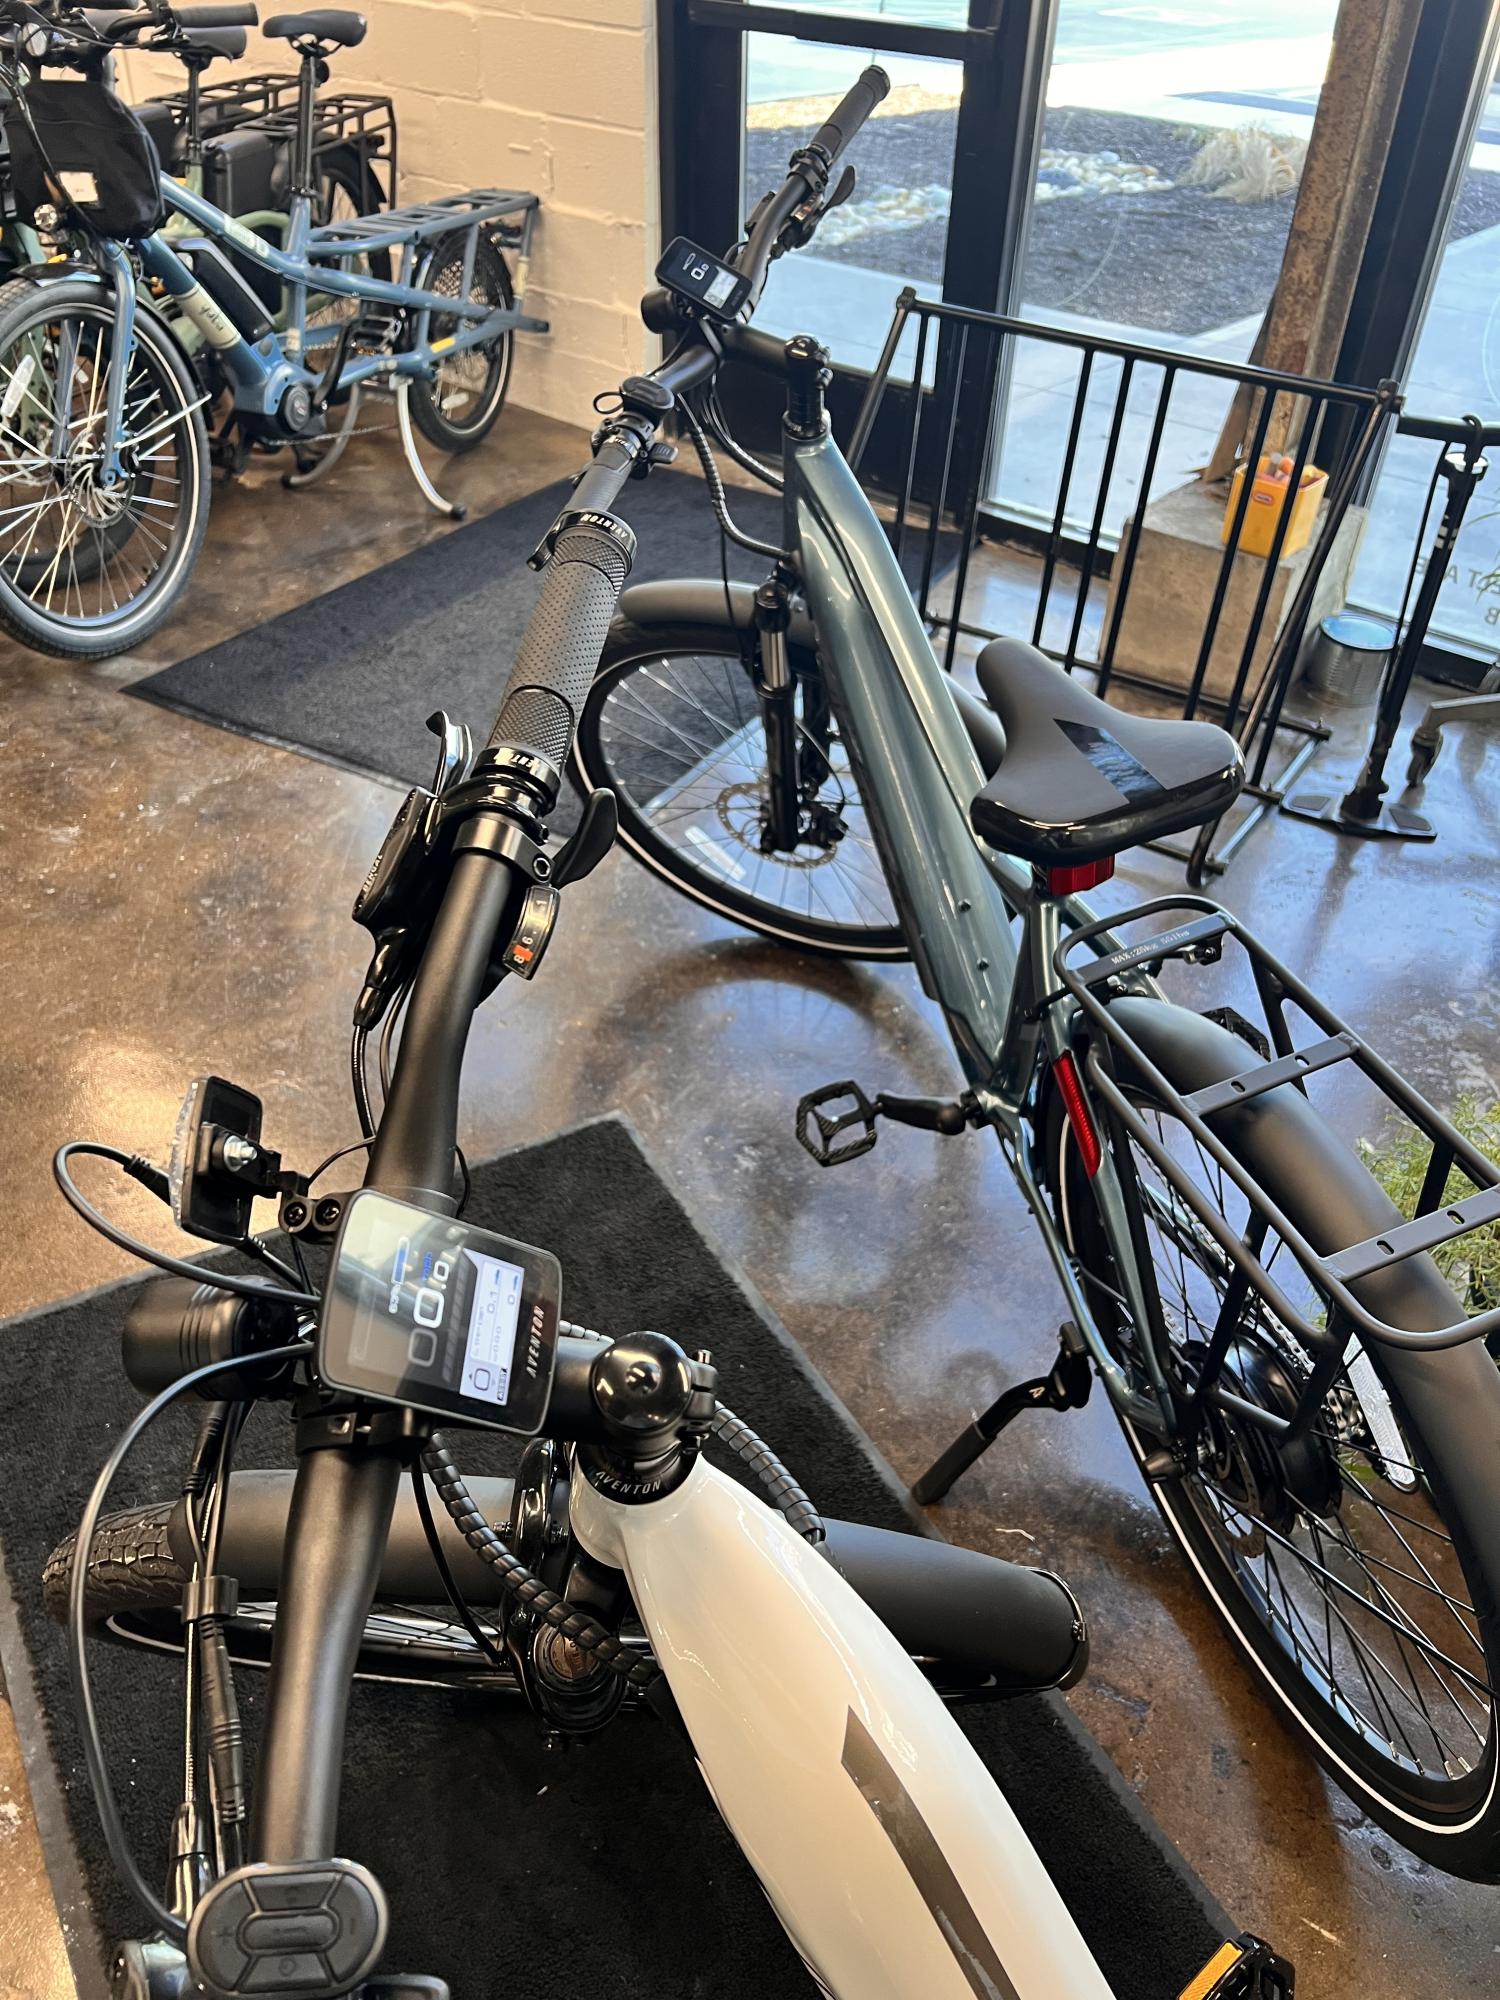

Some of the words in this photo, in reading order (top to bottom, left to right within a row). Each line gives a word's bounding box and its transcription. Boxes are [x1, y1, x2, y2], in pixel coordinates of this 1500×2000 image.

[580, 513, 628, 538] AVENTON
[361, 853, 384, 892] BENGAL
[525, 1305, 545, 1379] AVENTON
[595, 1471, 661, 1494] AVENTON
